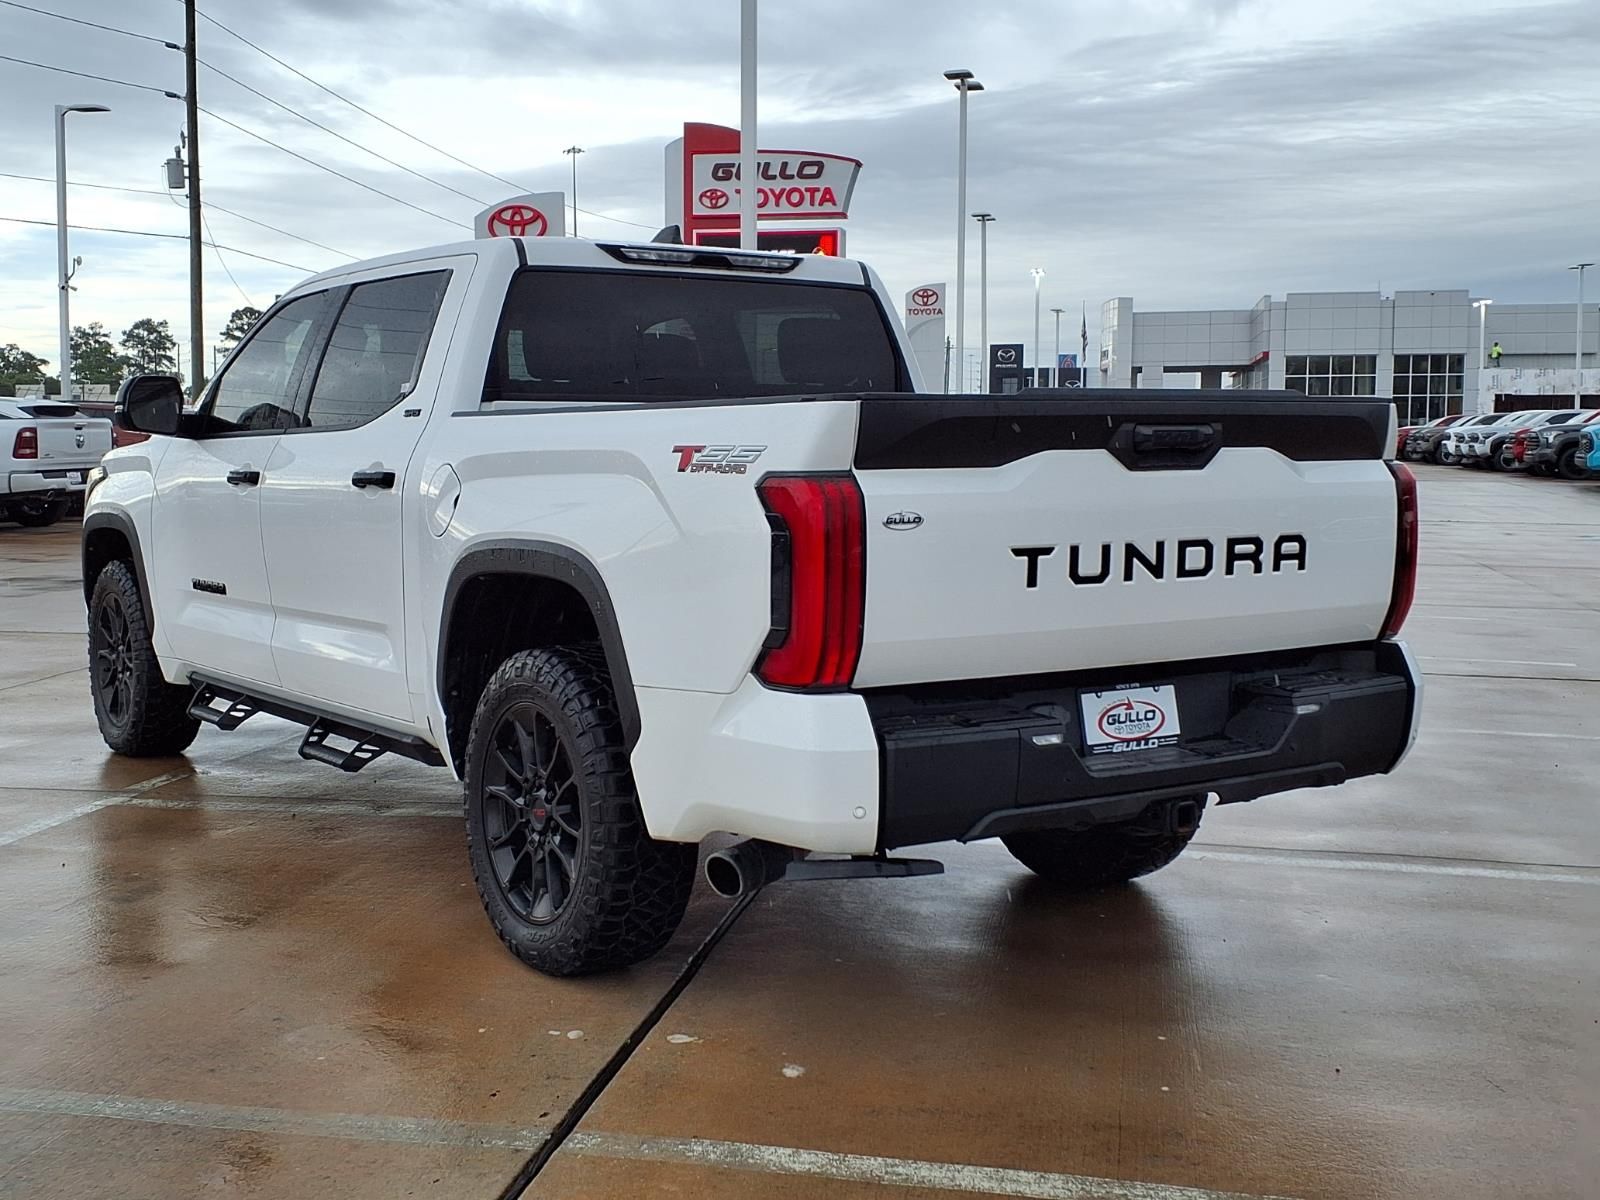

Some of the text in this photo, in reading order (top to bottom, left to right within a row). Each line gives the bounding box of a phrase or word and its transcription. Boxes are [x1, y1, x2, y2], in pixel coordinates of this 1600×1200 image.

[908, 308, 943, 316] TOYOTA
[886, 516, 922, 524] GULLO
[1009, 533, 1307, 588] TUNDRA
[1106, 709, 1156, 726] GULLO
[1125, 722, 1151, 731] TOYOTA
[1112, 738, 1158, 753] GULLO
